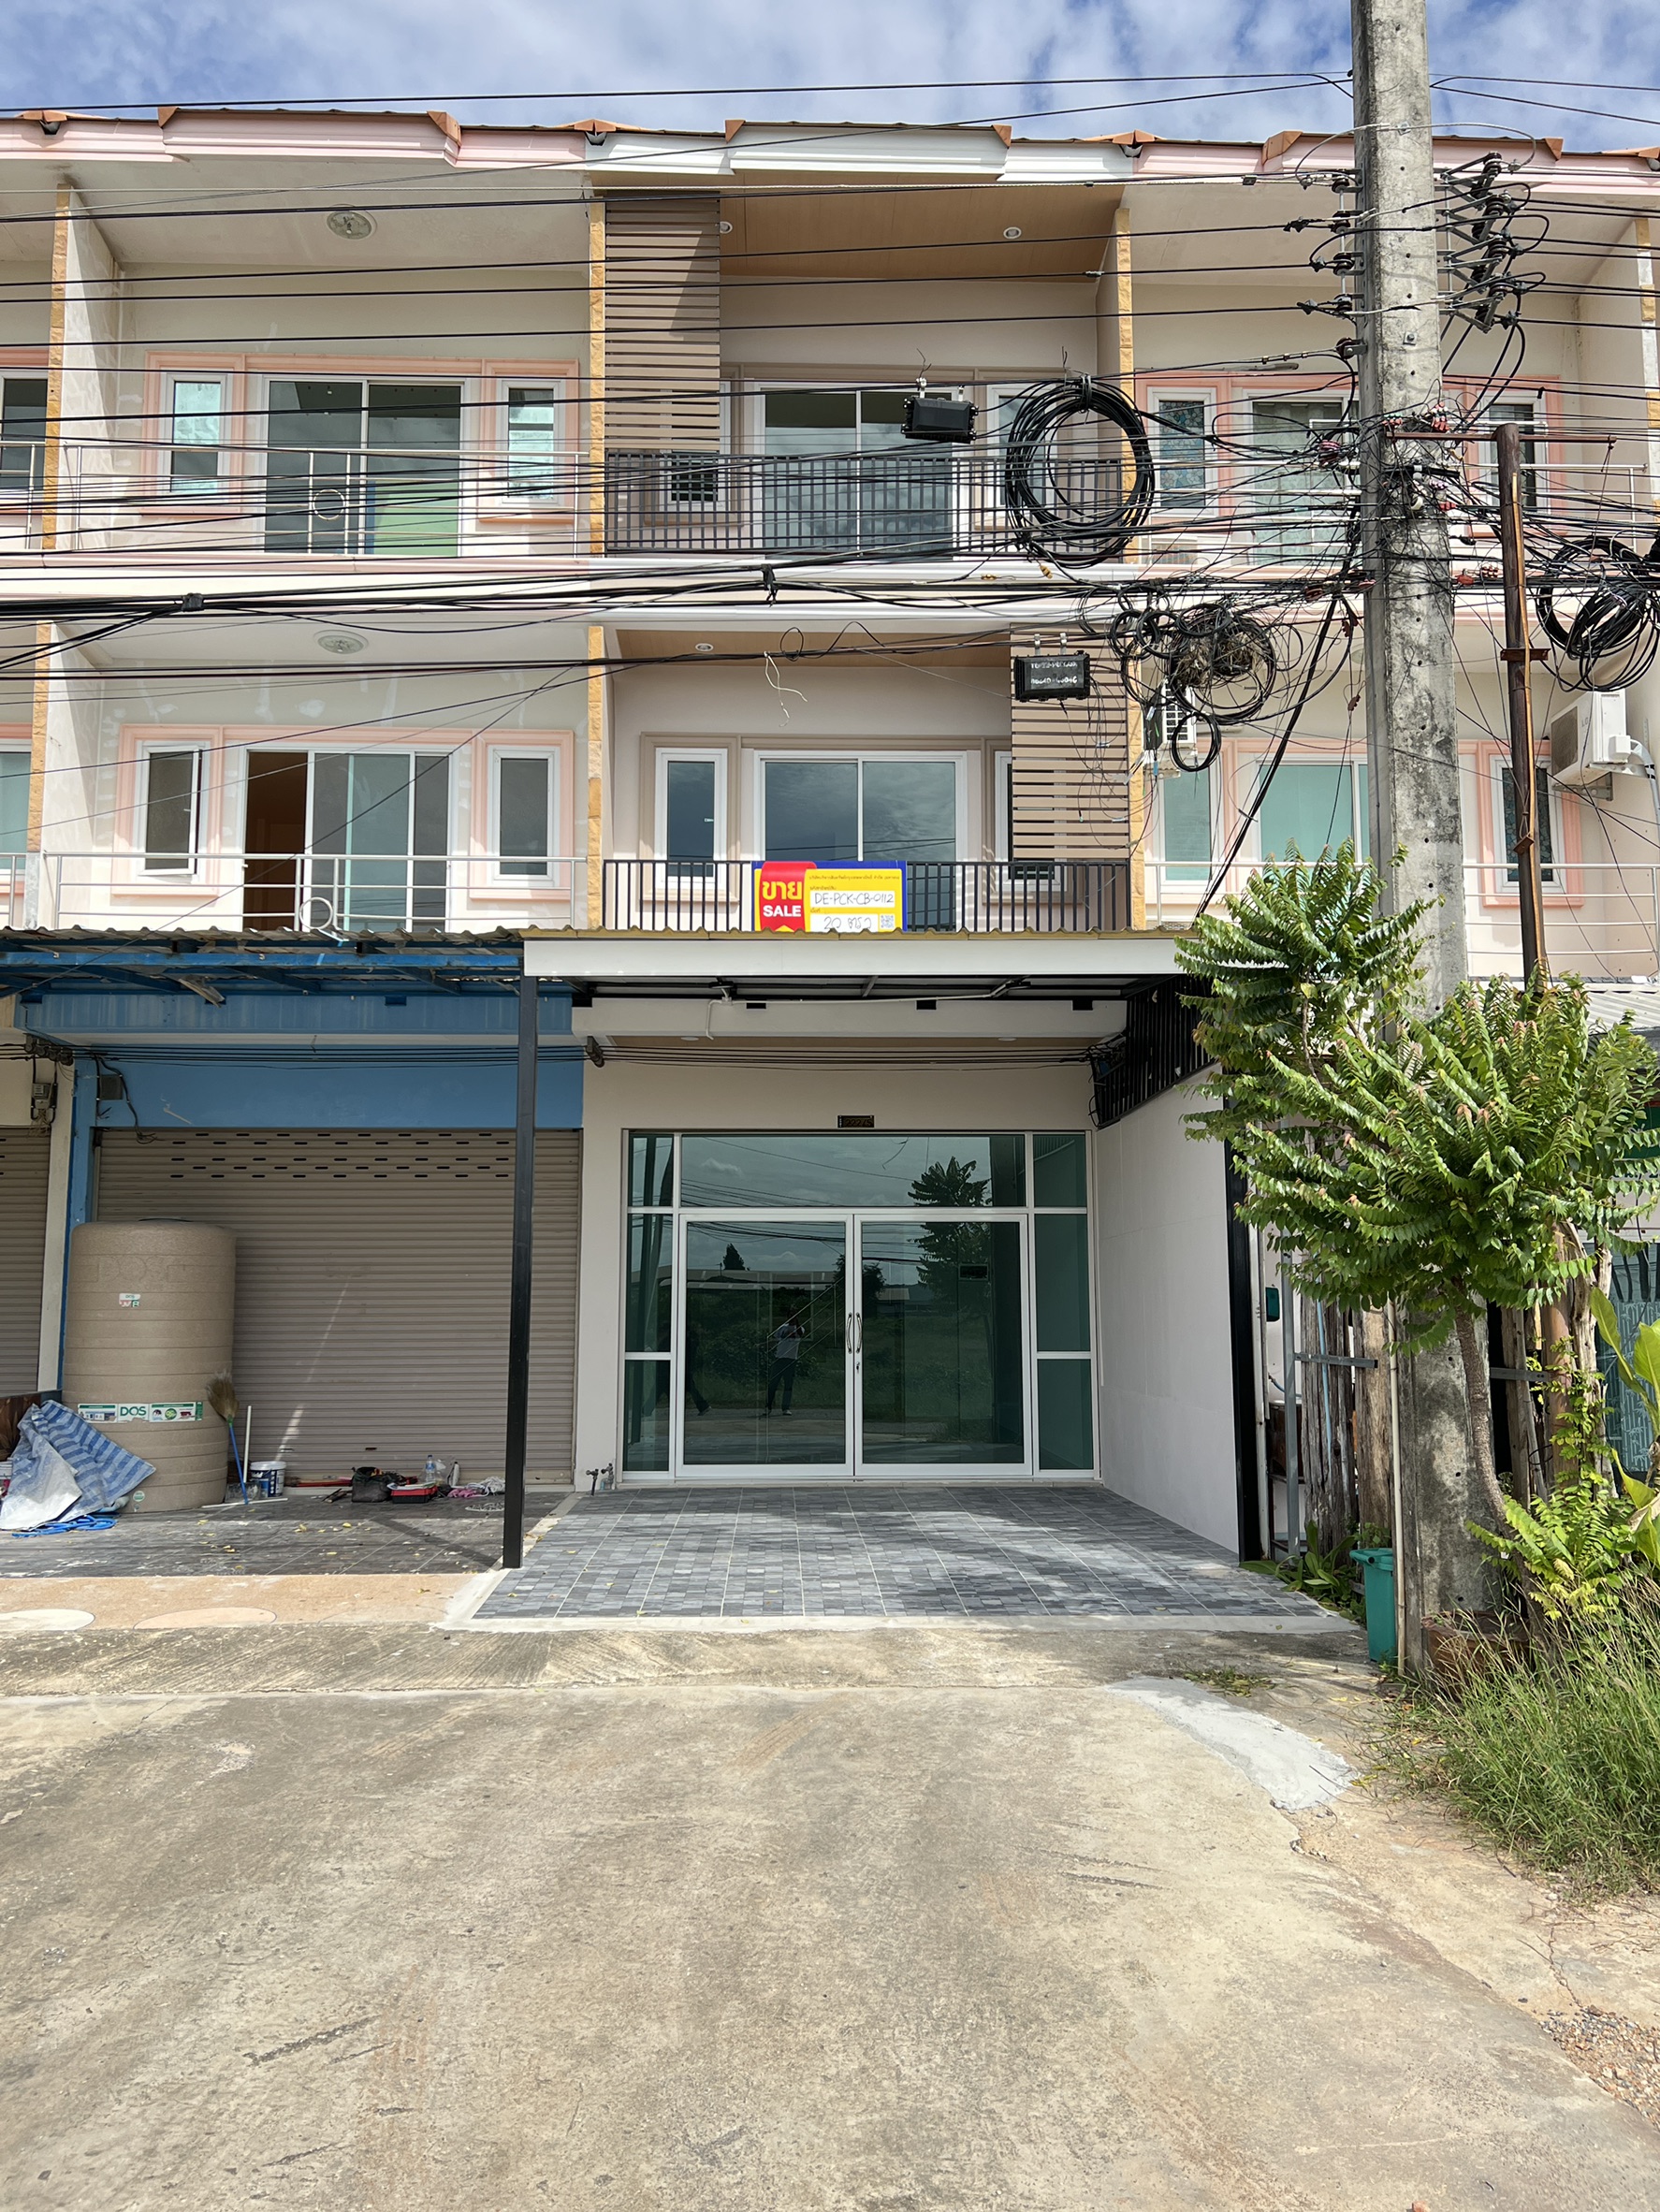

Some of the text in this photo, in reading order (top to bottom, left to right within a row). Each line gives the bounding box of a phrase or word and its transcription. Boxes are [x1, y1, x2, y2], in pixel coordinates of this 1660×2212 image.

[763, 881, 802, 900] ขาย
[763, 905, 801, 917] SALE
[120, 1406, 147, 1416] DOS
